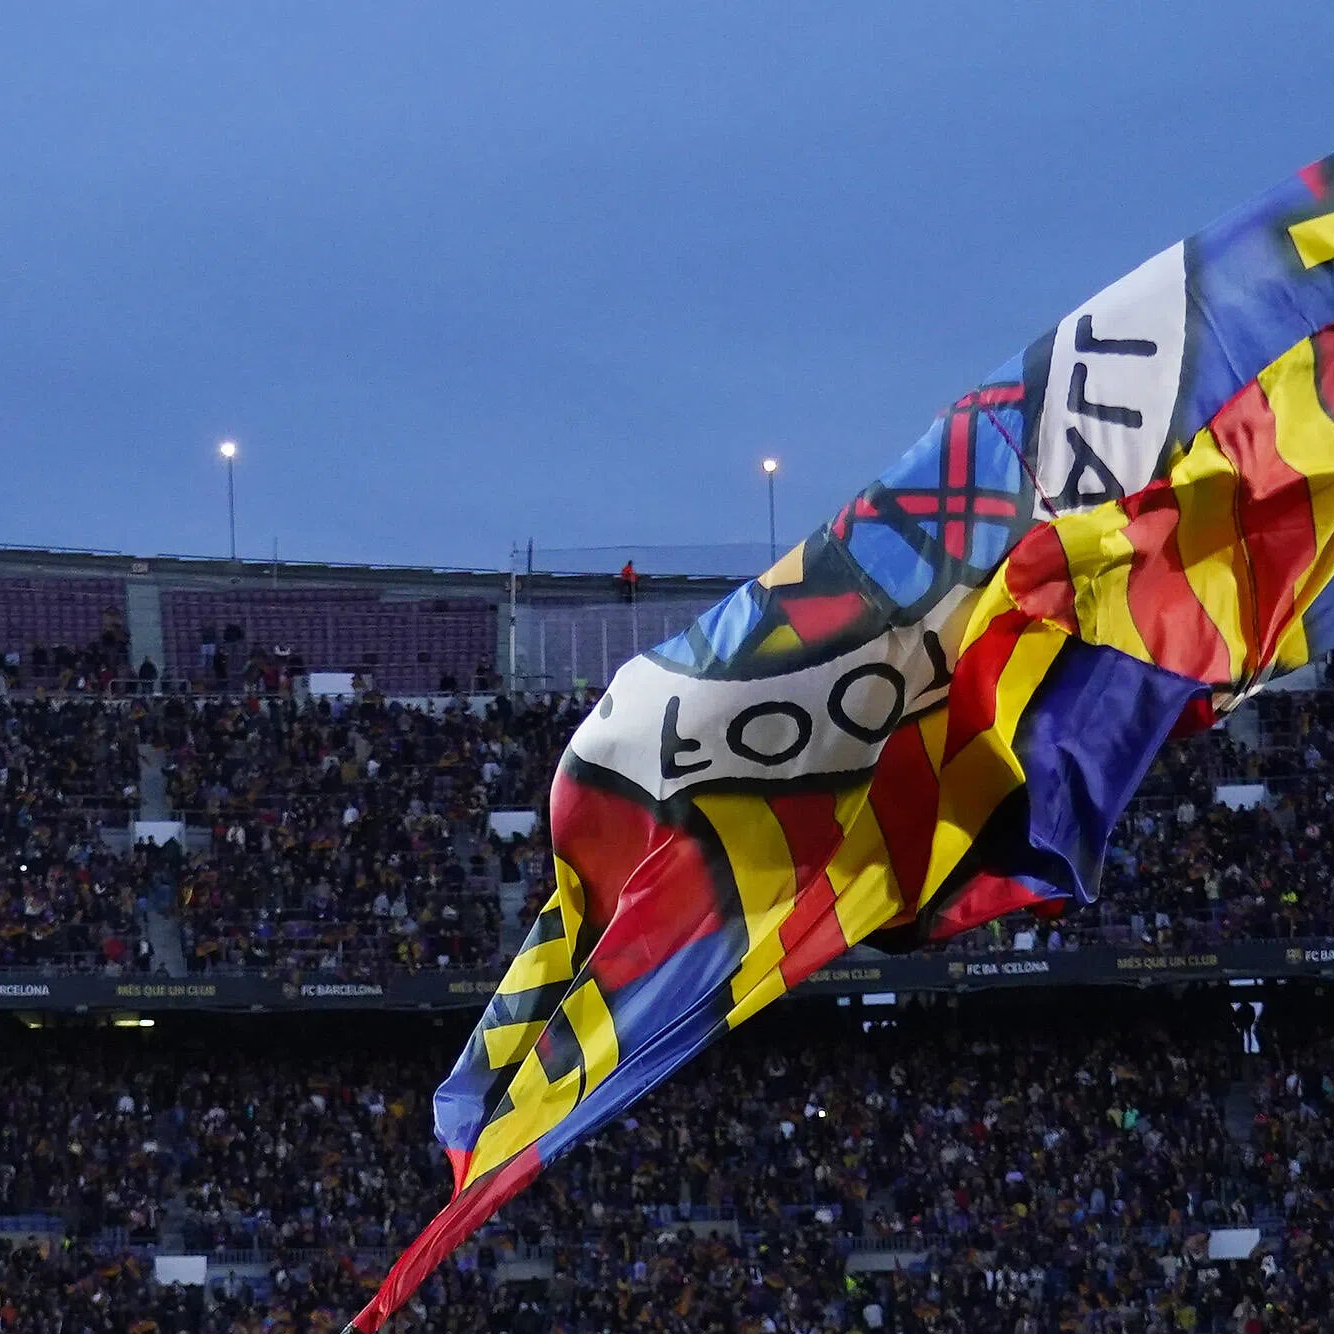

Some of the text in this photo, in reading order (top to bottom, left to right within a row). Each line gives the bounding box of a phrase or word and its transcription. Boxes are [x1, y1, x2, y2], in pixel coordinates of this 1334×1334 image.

[1305, 950, 1319, 961] FC
[967, 961, 1049, 975] FC BACELONA
[301, 985, 383, 996] FC BARCELONA
